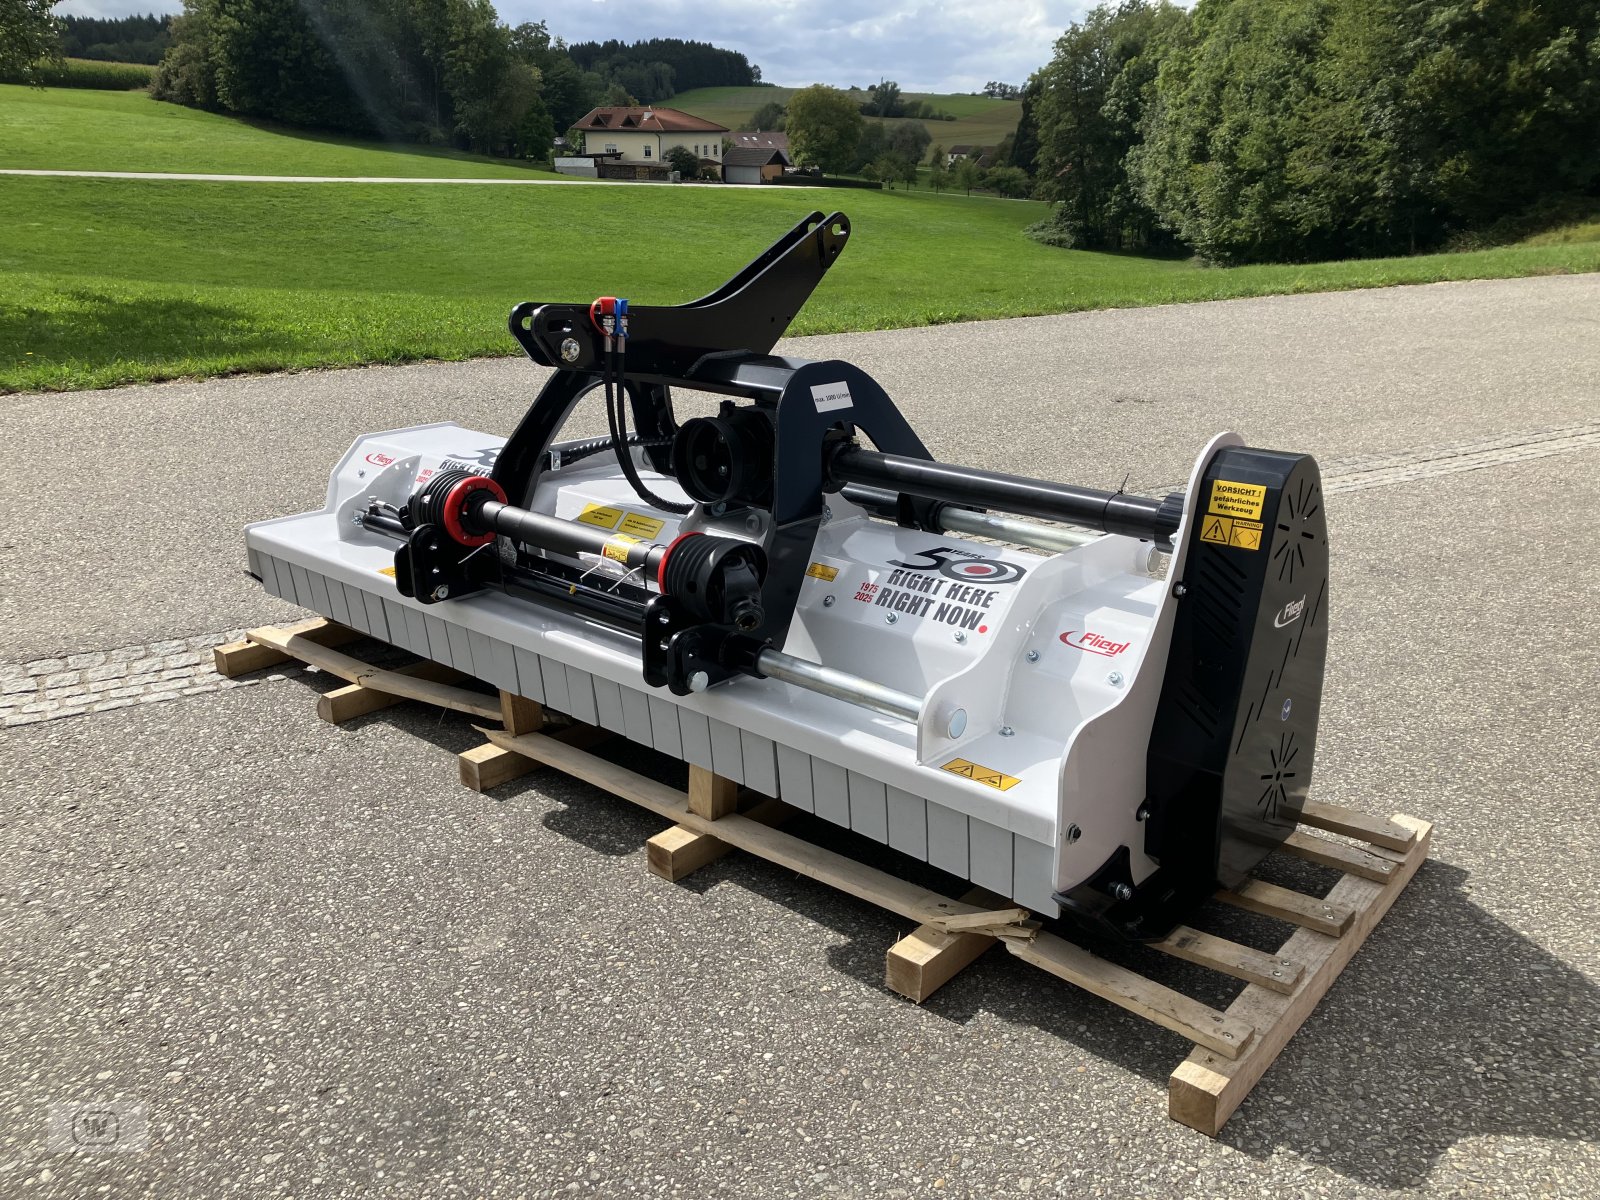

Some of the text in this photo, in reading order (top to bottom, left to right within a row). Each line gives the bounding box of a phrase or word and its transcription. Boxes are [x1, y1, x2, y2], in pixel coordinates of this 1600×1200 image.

[1216, 485, 1257, 496] VORSICHT
[1213, 495, 1260, 507] gefährliches
[1217, 503, 1253, 515] Werkzeug
[1235, 521, 1262, 529] WARNING!
[950, 549, 985, 559] YEARS
[860, 582, 879, 593] 1975
[887, 569, 999, 609] RIGHT HERE
[853, 591, 874, 603] 2025
[874, 587, 936, 618] RIGHT
[1079, 632, 1131, 655] Fliegl
